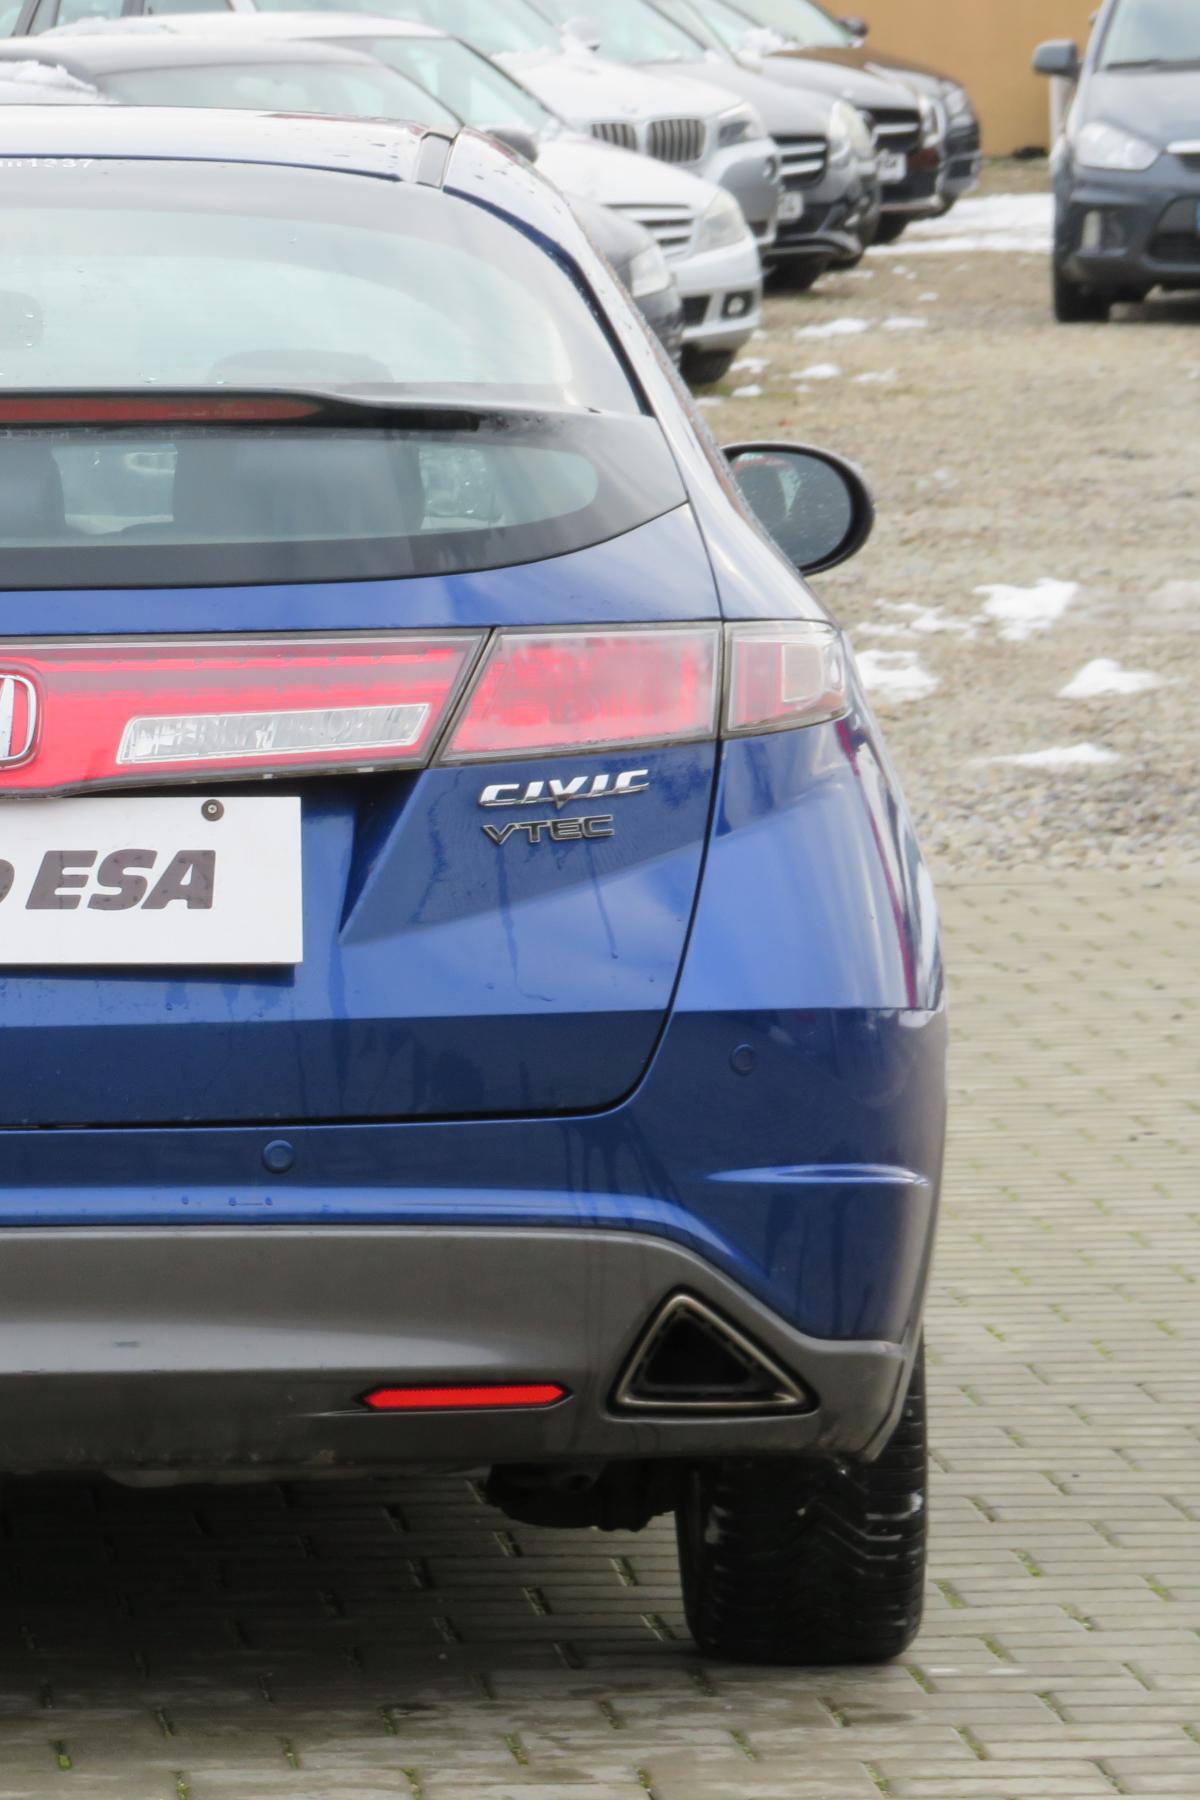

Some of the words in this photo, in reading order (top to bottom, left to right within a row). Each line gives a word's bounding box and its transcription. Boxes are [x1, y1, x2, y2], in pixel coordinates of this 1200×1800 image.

[479, 769, 650, 810] CIVIC
[481, 814, 616, 846] VTEC
[24, 848, 217, 912] ESA
